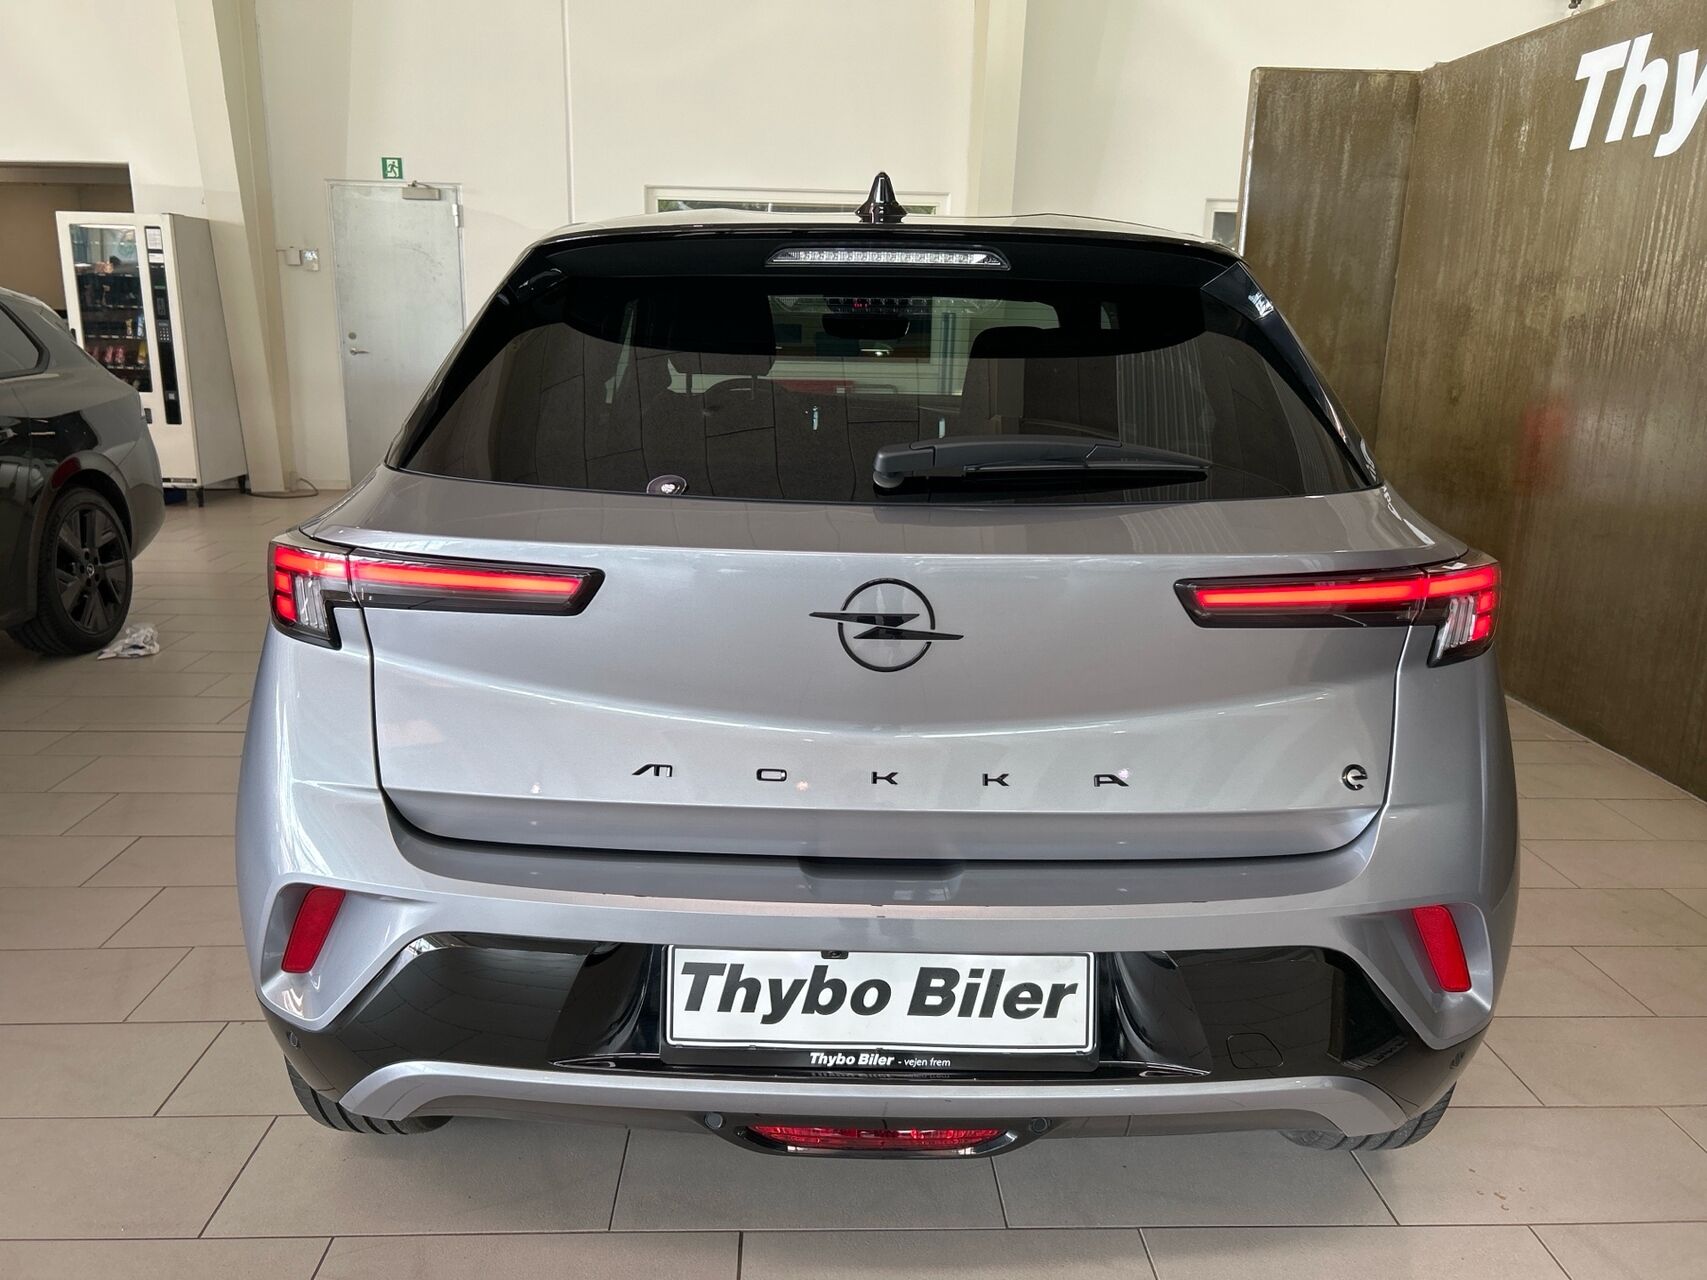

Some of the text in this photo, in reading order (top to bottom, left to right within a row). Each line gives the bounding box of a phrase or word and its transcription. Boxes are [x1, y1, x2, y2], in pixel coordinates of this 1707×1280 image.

[631, 763, 1129, 788] MOKKA
[680, 961, 1079, 1025] Thybo Biler
[809, 1052, 855, 1067] Thybo
[857, 1053, 895, 1066] Biler
[904, 1059, 928, 1068] vejen
[930, 1057, 951, 1067] frem
